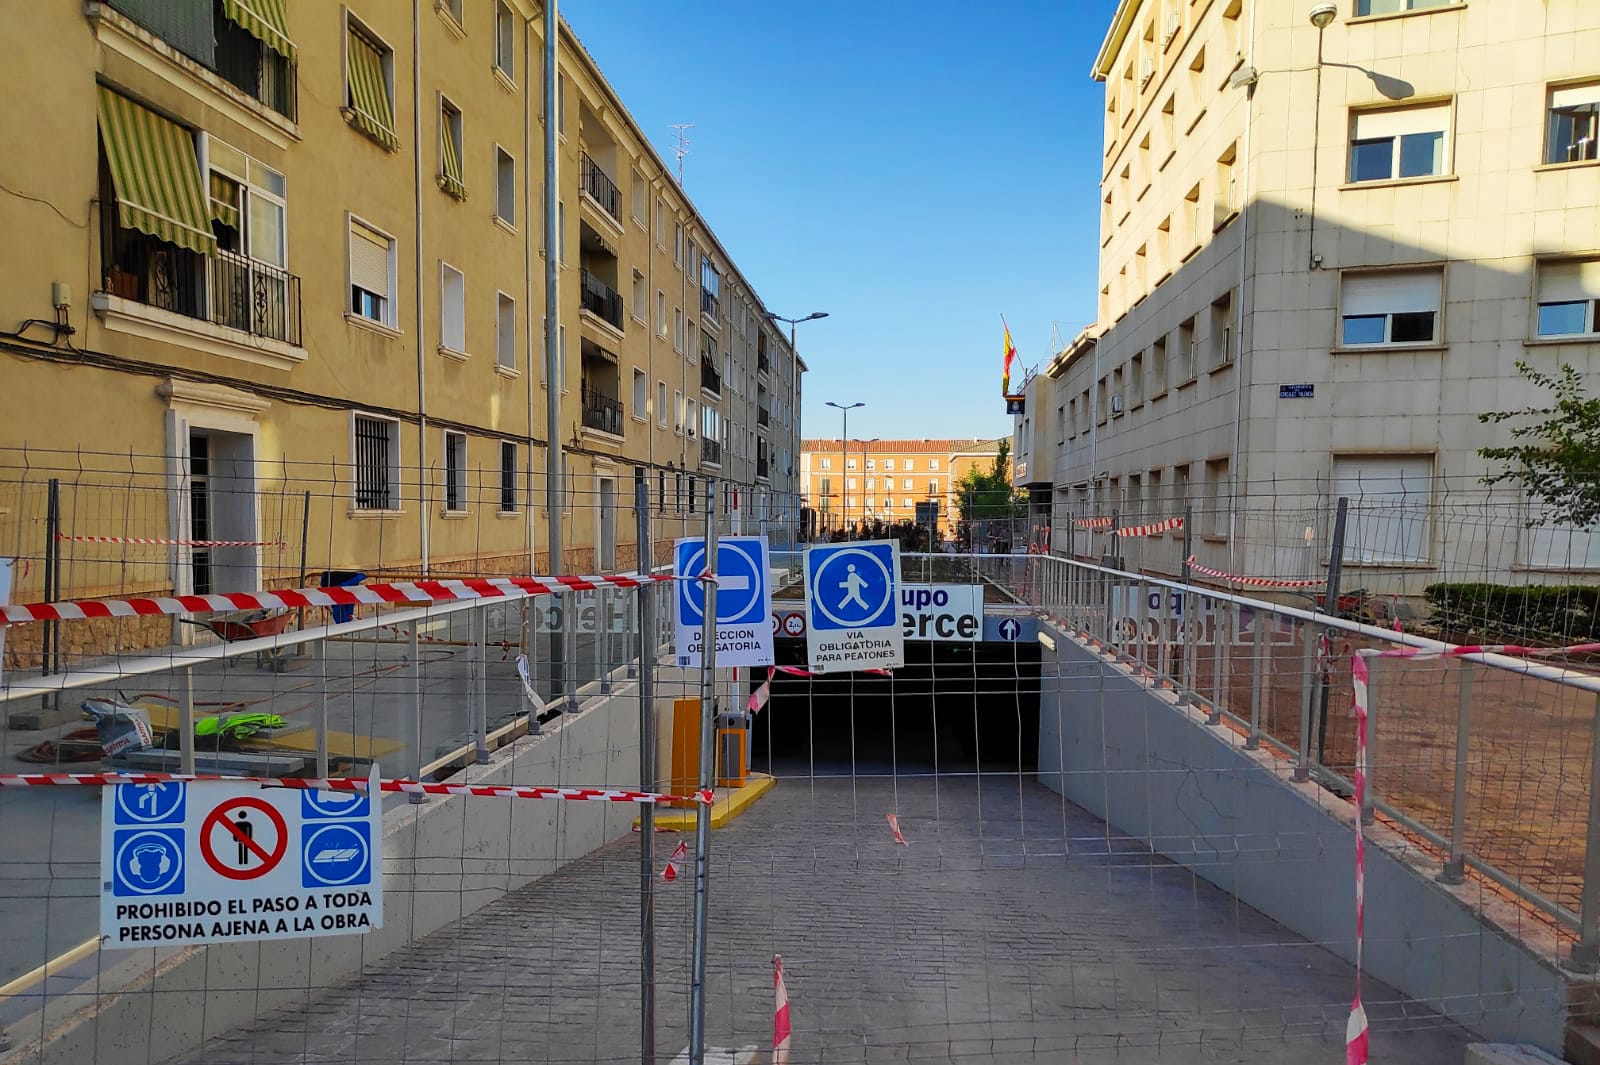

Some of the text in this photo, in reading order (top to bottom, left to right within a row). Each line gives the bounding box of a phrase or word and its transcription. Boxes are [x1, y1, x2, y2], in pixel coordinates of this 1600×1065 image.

[902, 589, 948, 610] upo
[903, 613, 979, 638] erce
[694, 630, 754, 641] DECCION
[846, 631, 864, 639] VIA
[687, 641, 761, 653] OBGATORIA
[819, 640, 892, 651] OBLIGATORIA
[816, 650, 895, 662] PARA PEATONES
[116, 891, 372, 920] PROHIBIDO EL PASO A TODA
[119, 913, 370, 942] PERSONA AJENA A LA OBRA
